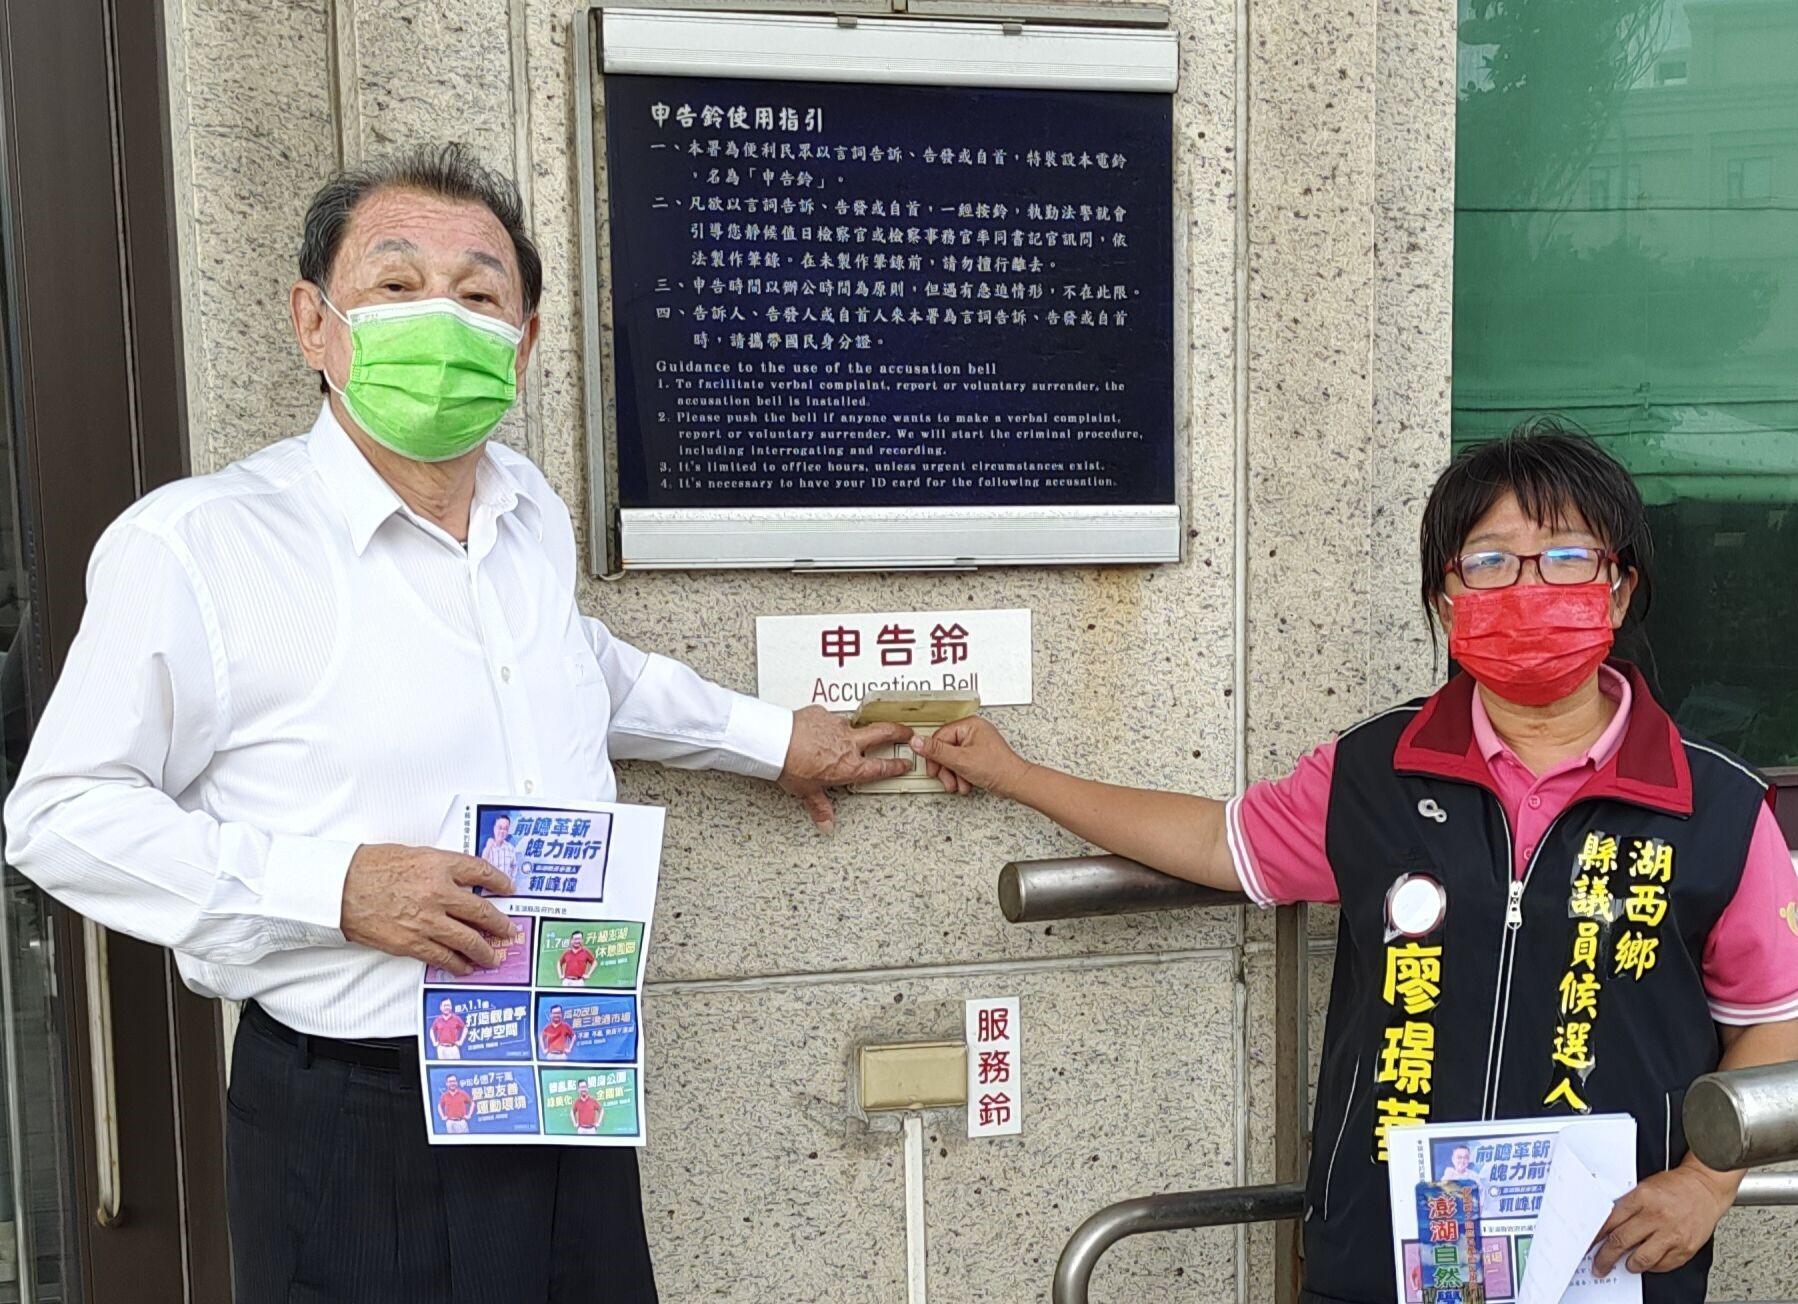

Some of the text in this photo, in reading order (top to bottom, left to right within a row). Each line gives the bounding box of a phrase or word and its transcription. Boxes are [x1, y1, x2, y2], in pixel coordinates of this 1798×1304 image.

[651, 102, 824, 132] 申告鈴使用指引
[655, 359, 997, 375] Guidance to the use of the accusation bell
[675, 378, 692, 389] To
[698, 377, 765, 390] facilitate
[769, 378, 813, 390] verbal
[896, 380, 939, 392] report
[942, 382, 958, 391] or
[962, 379, 1027, 393] voluntary
[1104, 380, 1125, 392] the
[677, 394, 751, 407] accusation
[756, 394, 782, 407] bell
[788, 395, 801, 407] is
[676, 411, 721, 423] Please
[726, 411, 758, 424] push
[763, 411, 786, 423] the
[791, 411, 817, 423] bell
[823, 411, 835, 423] if
[840, 414, 887, 424] anyone
[892, 412, 932, 423] wants
[937, 412, 950, 423] to
[955, 412, 989, 424] make
[994, 415, 1002, 423] a
[1006, 412, 1048, 424] verbal
[678, 428, 722, 440] report
[727, 430, 743, 439] or
[747, 428, 815, 441] voluntary
[896, 428, 915, 440] We
[919, 428, 946, 439] will
[951, 428, 985, 440] start
[989, 428, 1011, 439] the
[1015, 428, 1071, 439] criminal
[679, 444, 745, 457] including
[751, 444, 845, 457] interrogating
[849, 444, 874, 456] and
[707, 461, 757, 473] limited
[762, 461, 776, 473] to
[781, 461, 822, 473] office
[874, 460, 917, 472] unless
[921, 460, 967, 473] urgent
[971, 460, 1065, 473] circumstances
[707, 479, 774, 489] necessary
[779, 478, 794, 489] to
[799, 477, 830, 489] have
[835, 479, 866, 489] your
[870, 477, 887, 488] ID
[891, 476, 921, 489] card
[925, 476, 947, 488] for
[951, 476, 973, 488] the
[977, 476, 1040, 488] following
[821, 623, 970, 668] 申告鈴
[513, 817, 592, 838] 前瞻革新
[525, 838, 602, 860] 魄力前行
[528, 876, 578, 893] 賴峰偉
[1614, 840, 1674, 982] 湖西鄉
[1542, 831, 1619, 1113] 縣議員候選人
[977, 1007, 1011, 1126] 服務鈴
[1475, 1139, 1551, 1163] 前瞻革新
